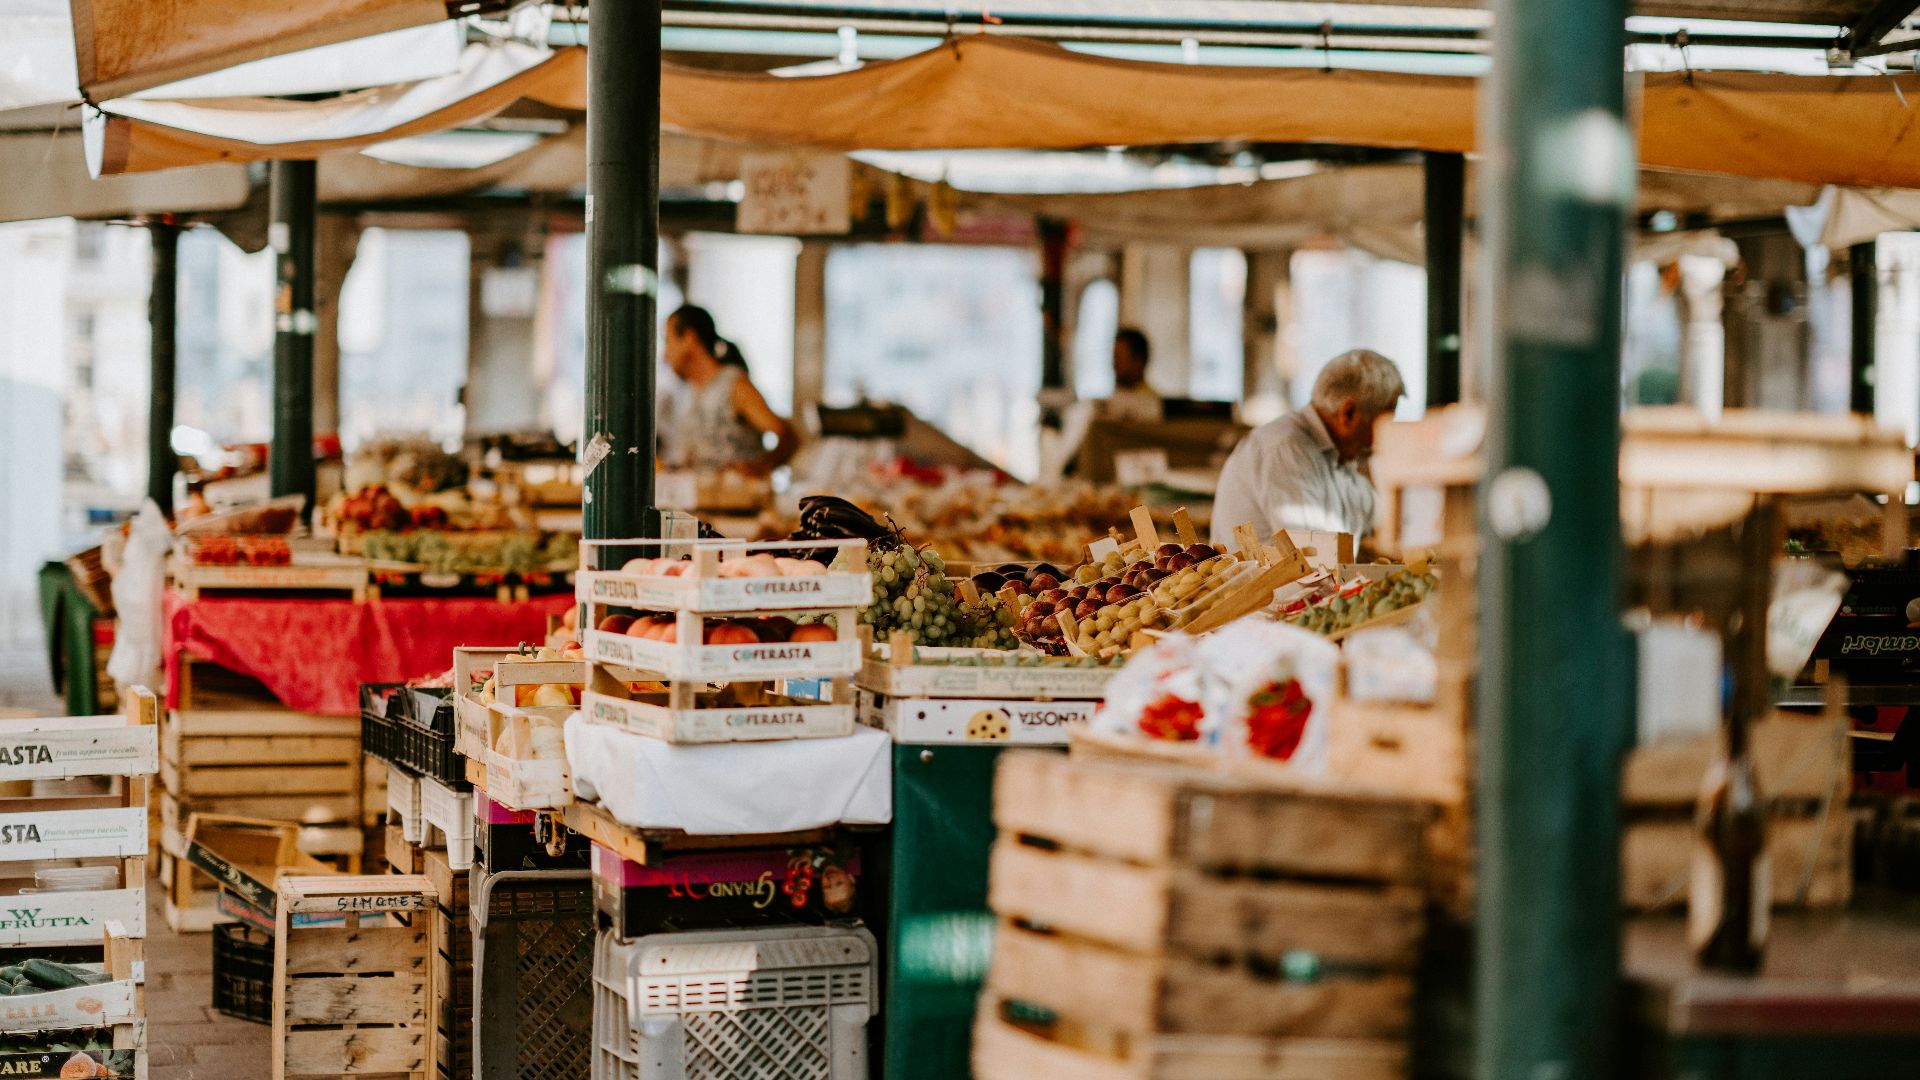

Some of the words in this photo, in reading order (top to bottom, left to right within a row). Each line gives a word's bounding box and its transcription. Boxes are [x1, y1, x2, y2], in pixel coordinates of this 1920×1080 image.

[745, 581, 822, 594] COFERASTA
[733, 648, 812, 661] COFERASTA
[726, 713, 805, 726] COFERASTA
